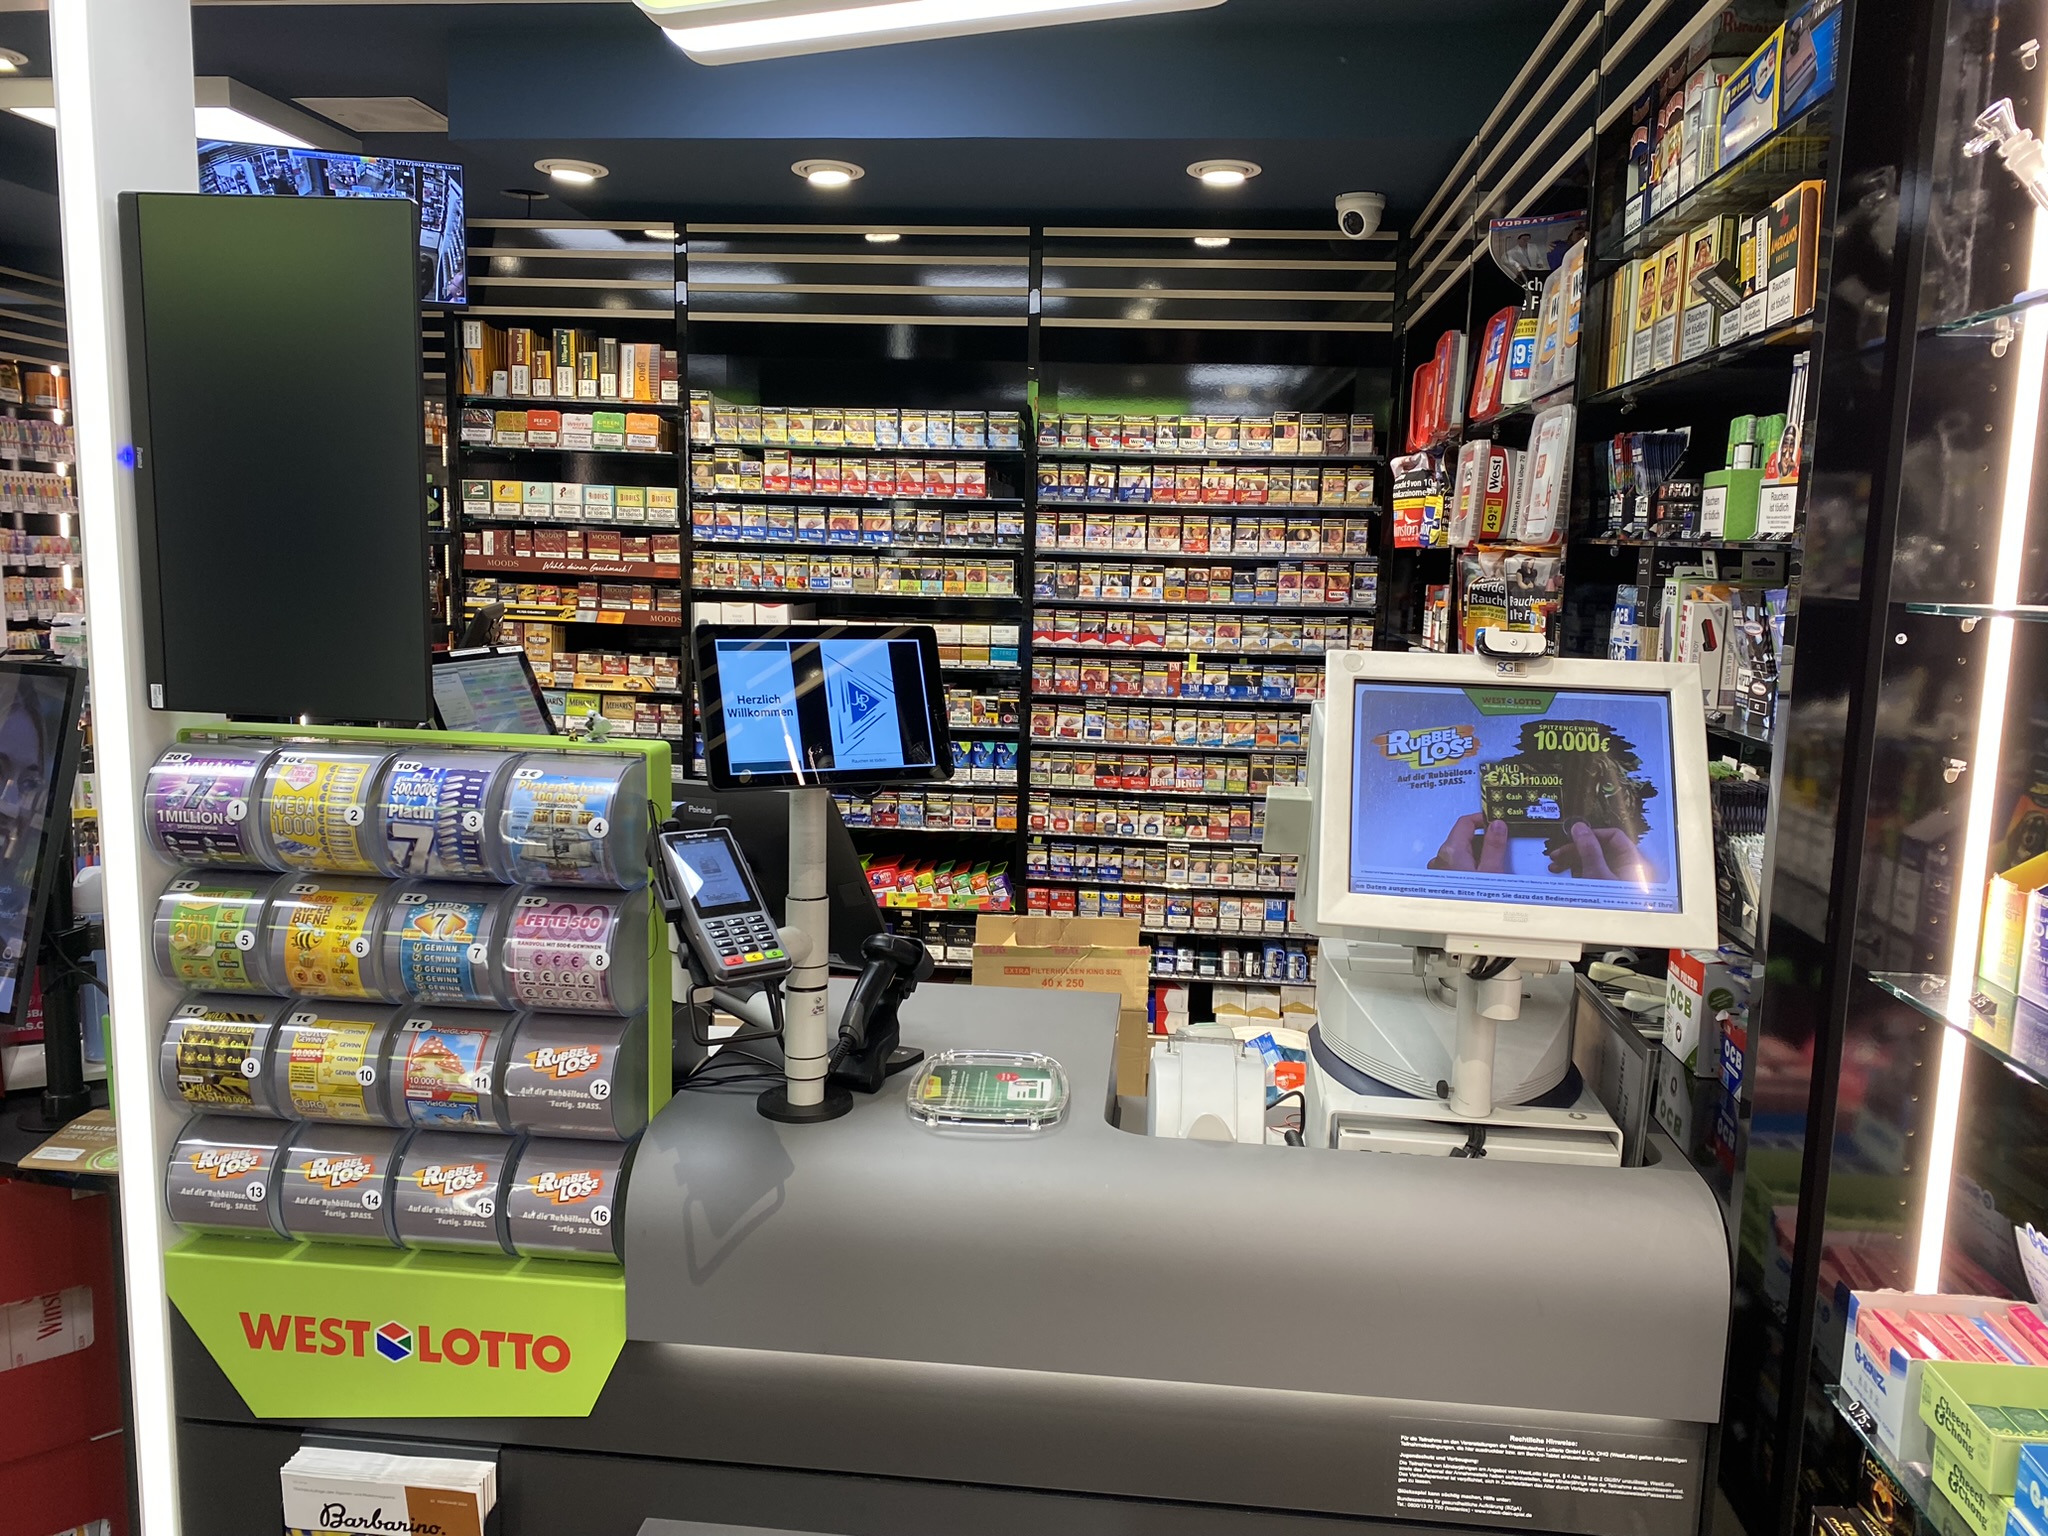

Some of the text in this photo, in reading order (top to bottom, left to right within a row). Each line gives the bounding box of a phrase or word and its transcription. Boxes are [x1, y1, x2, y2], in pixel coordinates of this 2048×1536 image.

[1772, 276, 1791, 292] Rauchen
[1488, 457, 1503, 493] West
[1771, 491, 1789, 501] Rauchen
[487, 559, 519, 567] MOODS
[811, 579, 825, 588] NIL
[1666, 586, 1677, 596] OCB
[650, 615, 682, 624] MOODS
[737, 695, 781, 704] Herzlich
[1482, 697, 1542, 705] WEST LOTTO
[726, 708, 794, 719] Willkommen
[1539, 724, 1599, 732] SPITZENGEWINN
[1388, 727, 1461, 755] RUBBEL
[1534, 730, 1611, 753] 10.000€
[1419, 736, 1473, 765] LOSE
[1397, 769, 1476, 783] Auf die Rubbellose.
[1530, 776, 1563, 785] 10.000€
[1410, 778, 1466, 789] Fertig. SPASS.
[273, 796, 315, 815] MEGA
[388, 804, 434, 819] Platin
[688, 804, 712, 815] Poindus
[166, 810, 223, 825] MILLION
[350, 810, 358, 821] 2
[469, 816, 477, 827] 3
[594, 822, 602, 833] 4
[1366, 883, 1387, 891] Daten
[1388, 886, 1426, 894] ausgestellt
[1457, 889, 1475, 897] Bitte
[1477, 891, 1501, 899] fragen
[1514, 893, 1530, 901] dazu
[424, 902, 470, 913] SUPER
[292, 913, 328, 925] BIENE
[526, 914, 601, 929] FETTE 500
[174, 922, 211, 943] 200
[241, 935, 249, 946] 5
[355, 942, 363, 953] 6
[424, 943, 457, 952] GEWINN
[473, 948, 481, 959] 7
[424, 954, 456, 963] GEWINN
[595, 955, 603, 966] 8
[424, 965, 457, 974] GEWINN
[1004, 966, 1031, 975] EXTRA
[1106, 968, 1122, 976] SIZE
[1041, 979, 1054, 988] 40
[1066, 979, 1084, 988] 250
[1680, 970, 1698, 989] FILTER
[1670, 983, 1693, 1018] OCB
[535, 1047, 589, 1067] RUBBEL
[1724, 1039, 1742, 1071] OCB
[247, 1063, 255, 1073] 9
[557, 1053, 598, 1076] LOSE
[359, 1070, 373, 1082] 10
[474, 1077, 487, 1089] 11
[593, 1085, 608, 1096] 12
[198, 1150, 251, 1168] RUBBEL
[217, 1156, 258, 1178] LOSE
[310, 1157, 362, 1178] RUBBEL
[331, 1163, 370, 1186] LOSE
[423, 1164, 475, 1185] RUBBEL
[443, 1171, 483, 1195] LOSE
[538, 1172, 590, 1192] RUBBEL
[250, 1186, 263, 1197] 13
[559, 1178, 599, 1202] LOSE
[365, 1195, 379, 1206] 14
[478, 1203, 492, 1214] 15
[593, 1210, 607, 1221] 16
[239, 1311, 571, 1374] WEST LOTTO
[1940, 1396, 1972, 1440] Cheech
[1546, 1438, 1578, 1447] Hinweise:
[1945, 1416, 1975, 1460] Chong
[1953, 1463, 1986, 1510] Cheech
[1958, 1486, 1989, 1531] Chong
[319, 1502, 446, 1536] Barbarino.
